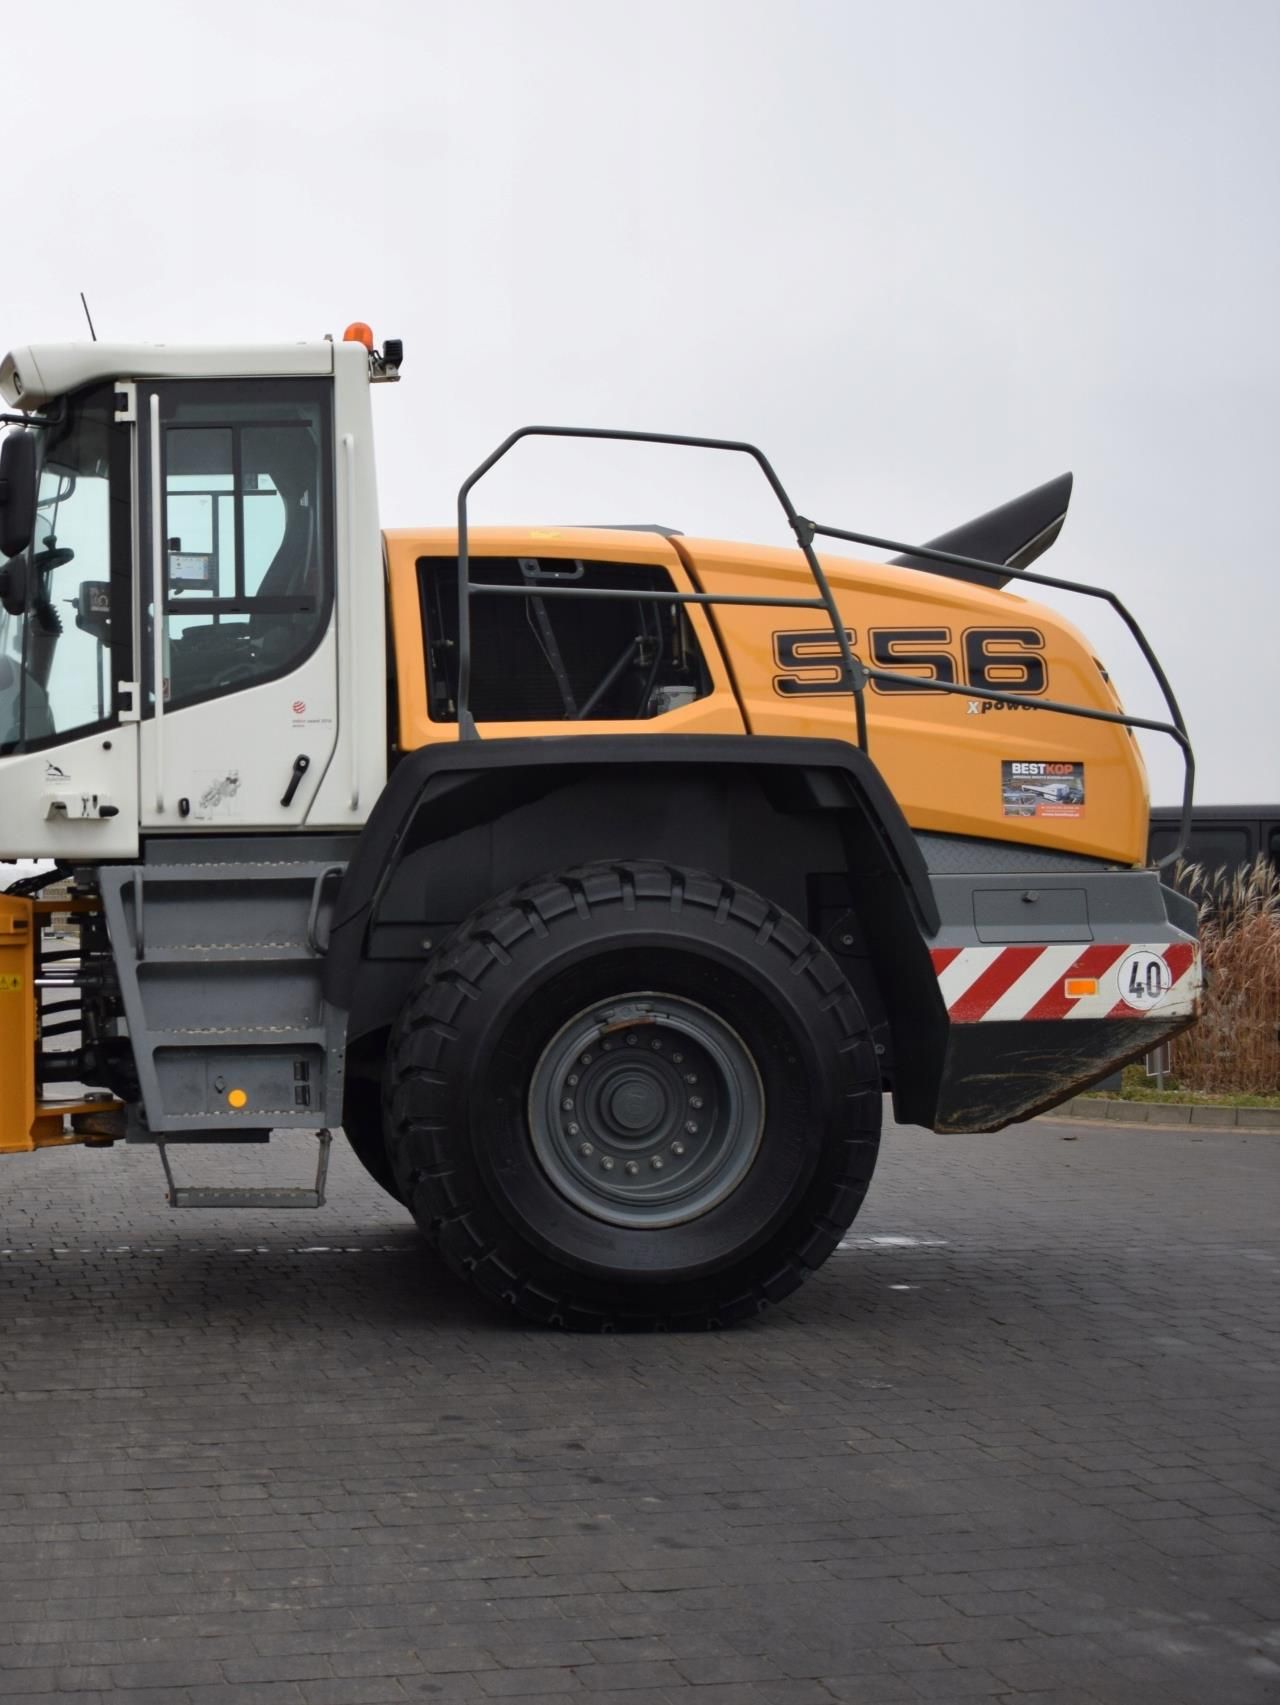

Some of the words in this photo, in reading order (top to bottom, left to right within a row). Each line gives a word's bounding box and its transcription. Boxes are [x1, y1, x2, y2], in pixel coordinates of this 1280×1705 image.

[772, 626, 1049, 698] 556
[1012, 763, 1073, 775] BESTKOP
[1128, 961, 1161, 998] 40
